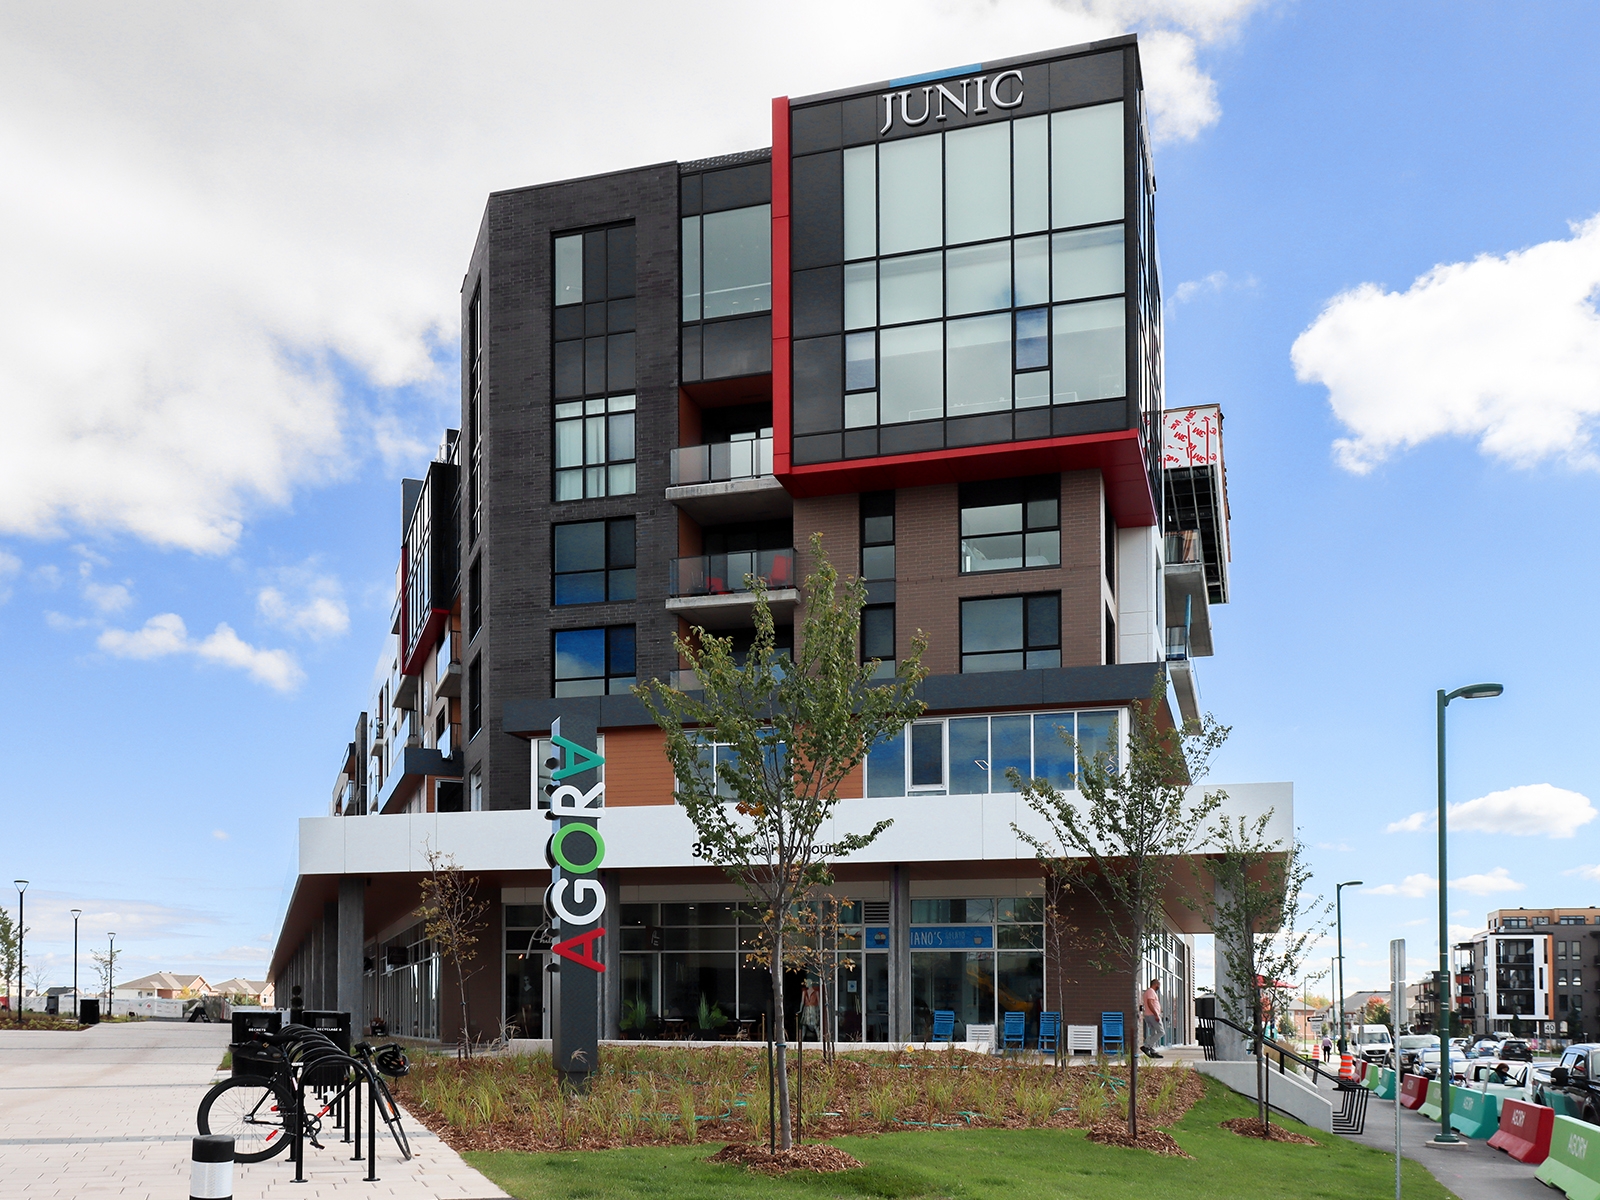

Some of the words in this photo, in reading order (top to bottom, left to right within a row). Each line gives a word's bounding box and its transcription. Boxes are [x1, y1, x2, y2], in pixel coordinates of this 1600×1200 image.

[880, 70, 1024, 135] JUNIC
[550, 734, 607, 973] AGORA
[692, 842, 713, 858] 35
[751, 844, 767, 856] de
